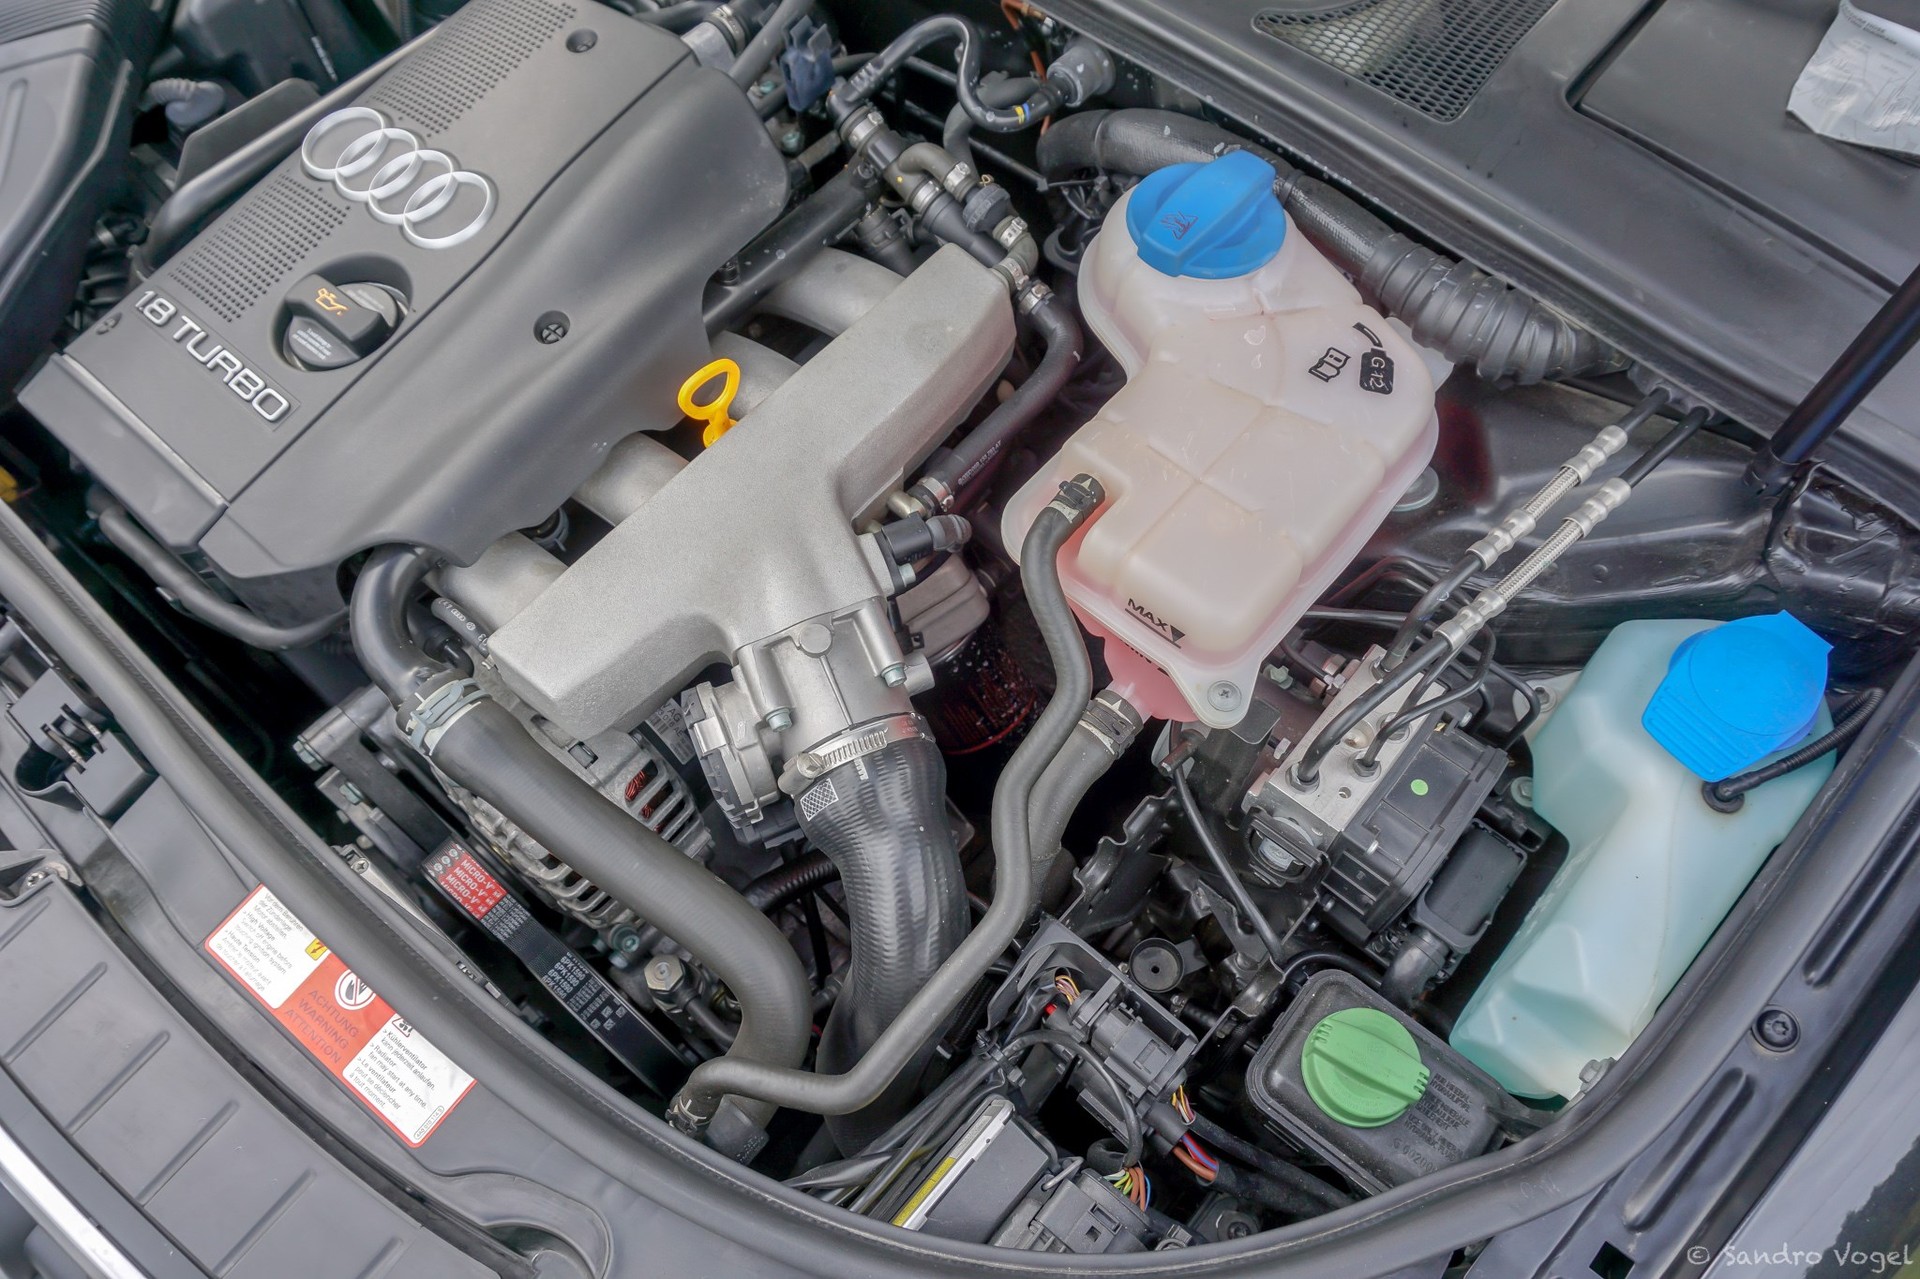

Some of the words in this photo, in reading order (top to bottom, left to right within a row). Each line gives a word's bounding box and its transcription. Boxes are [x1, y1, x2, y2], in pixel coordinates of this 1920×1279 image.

[172, 315, 291, 422] TURBO
[1127, 598, 1169, 632] MAX
[445, 874, 478, 905] MICRO-V
[453, 866, 486, 897] MICRO-V
[461, 859, 493, 890] MICRO-V
[246, 912, 259, 925] High
[257, 923, 276, 942] Voltage
[253, 906, 268, 920] Motor
[272, 901, 284, 912] dem
[282, 910, 304, 932] Berühren
[228, 931, 243, 946] Haute
[242, 944, 261, 963] Tension
[296, 998, 351, 1049] WARNING
[307, 988, 361, 1038] ACHTUNG
[283, 1007, 344, 1064] ATTENTION
[387, 1031, 428, 1071] Kühlerventilator
[374, 1045, 397, 1068] Radiator
[381, 1037, 395, 1051] kann
[391, 1048, 415, 1071] jederzeit
[361, 1059, 370, 1068] Le
[368, 1066, 397, 1094] ventilateur
[368, 1051, 378, 1062] fan
[376, 1060, 389, 1073] may
[387, 1070, 400, 1083] start
[403, 1086, 415, 1098] any
[373, 1083, 402, 1110] déclencher
